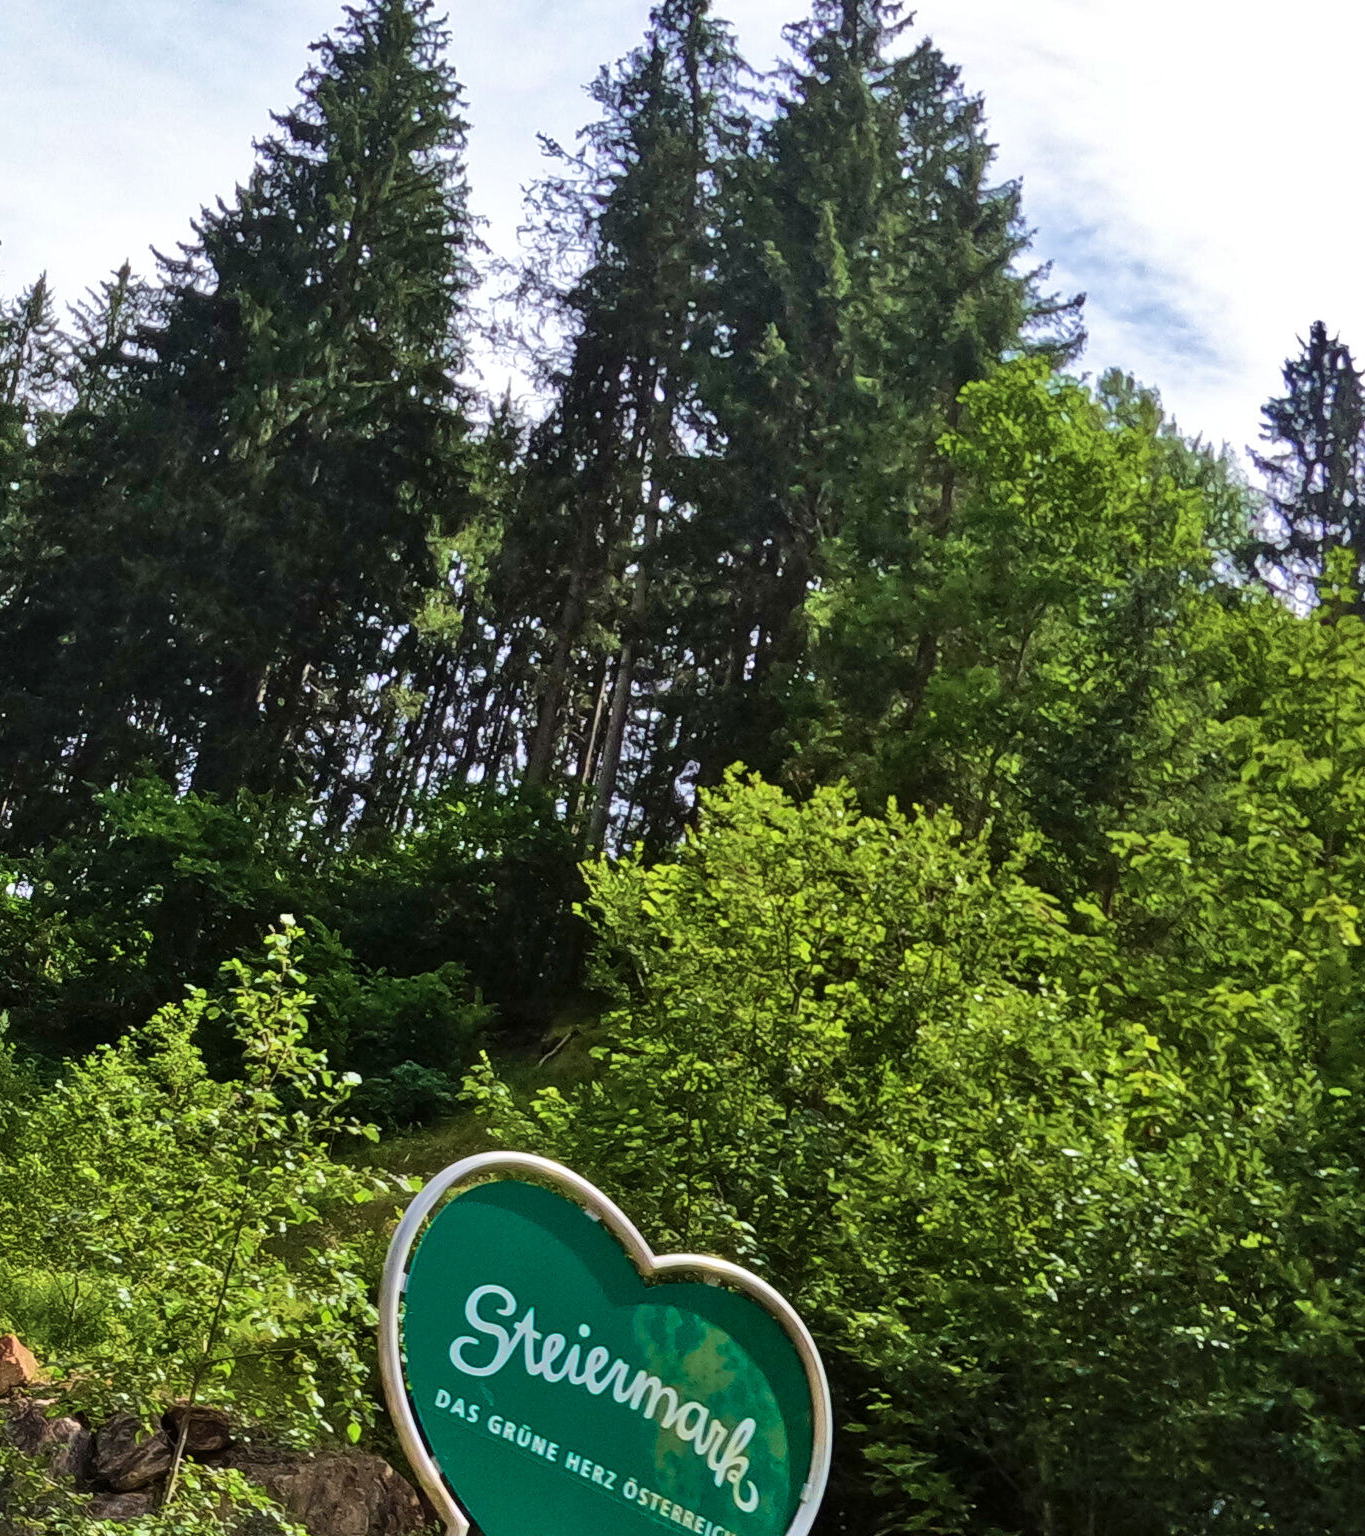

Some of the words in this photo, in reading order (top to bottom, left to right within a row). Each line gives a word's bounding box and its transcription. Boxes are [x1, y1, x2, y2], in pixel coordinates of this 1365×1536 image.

[434, 1389, 480, 1423] DAS
[487, 1415, 560, 1462] GRÜNE
[565, 1451, 616, 1491] HERZ
[449, 1284, 759, 1513] Steiermark
